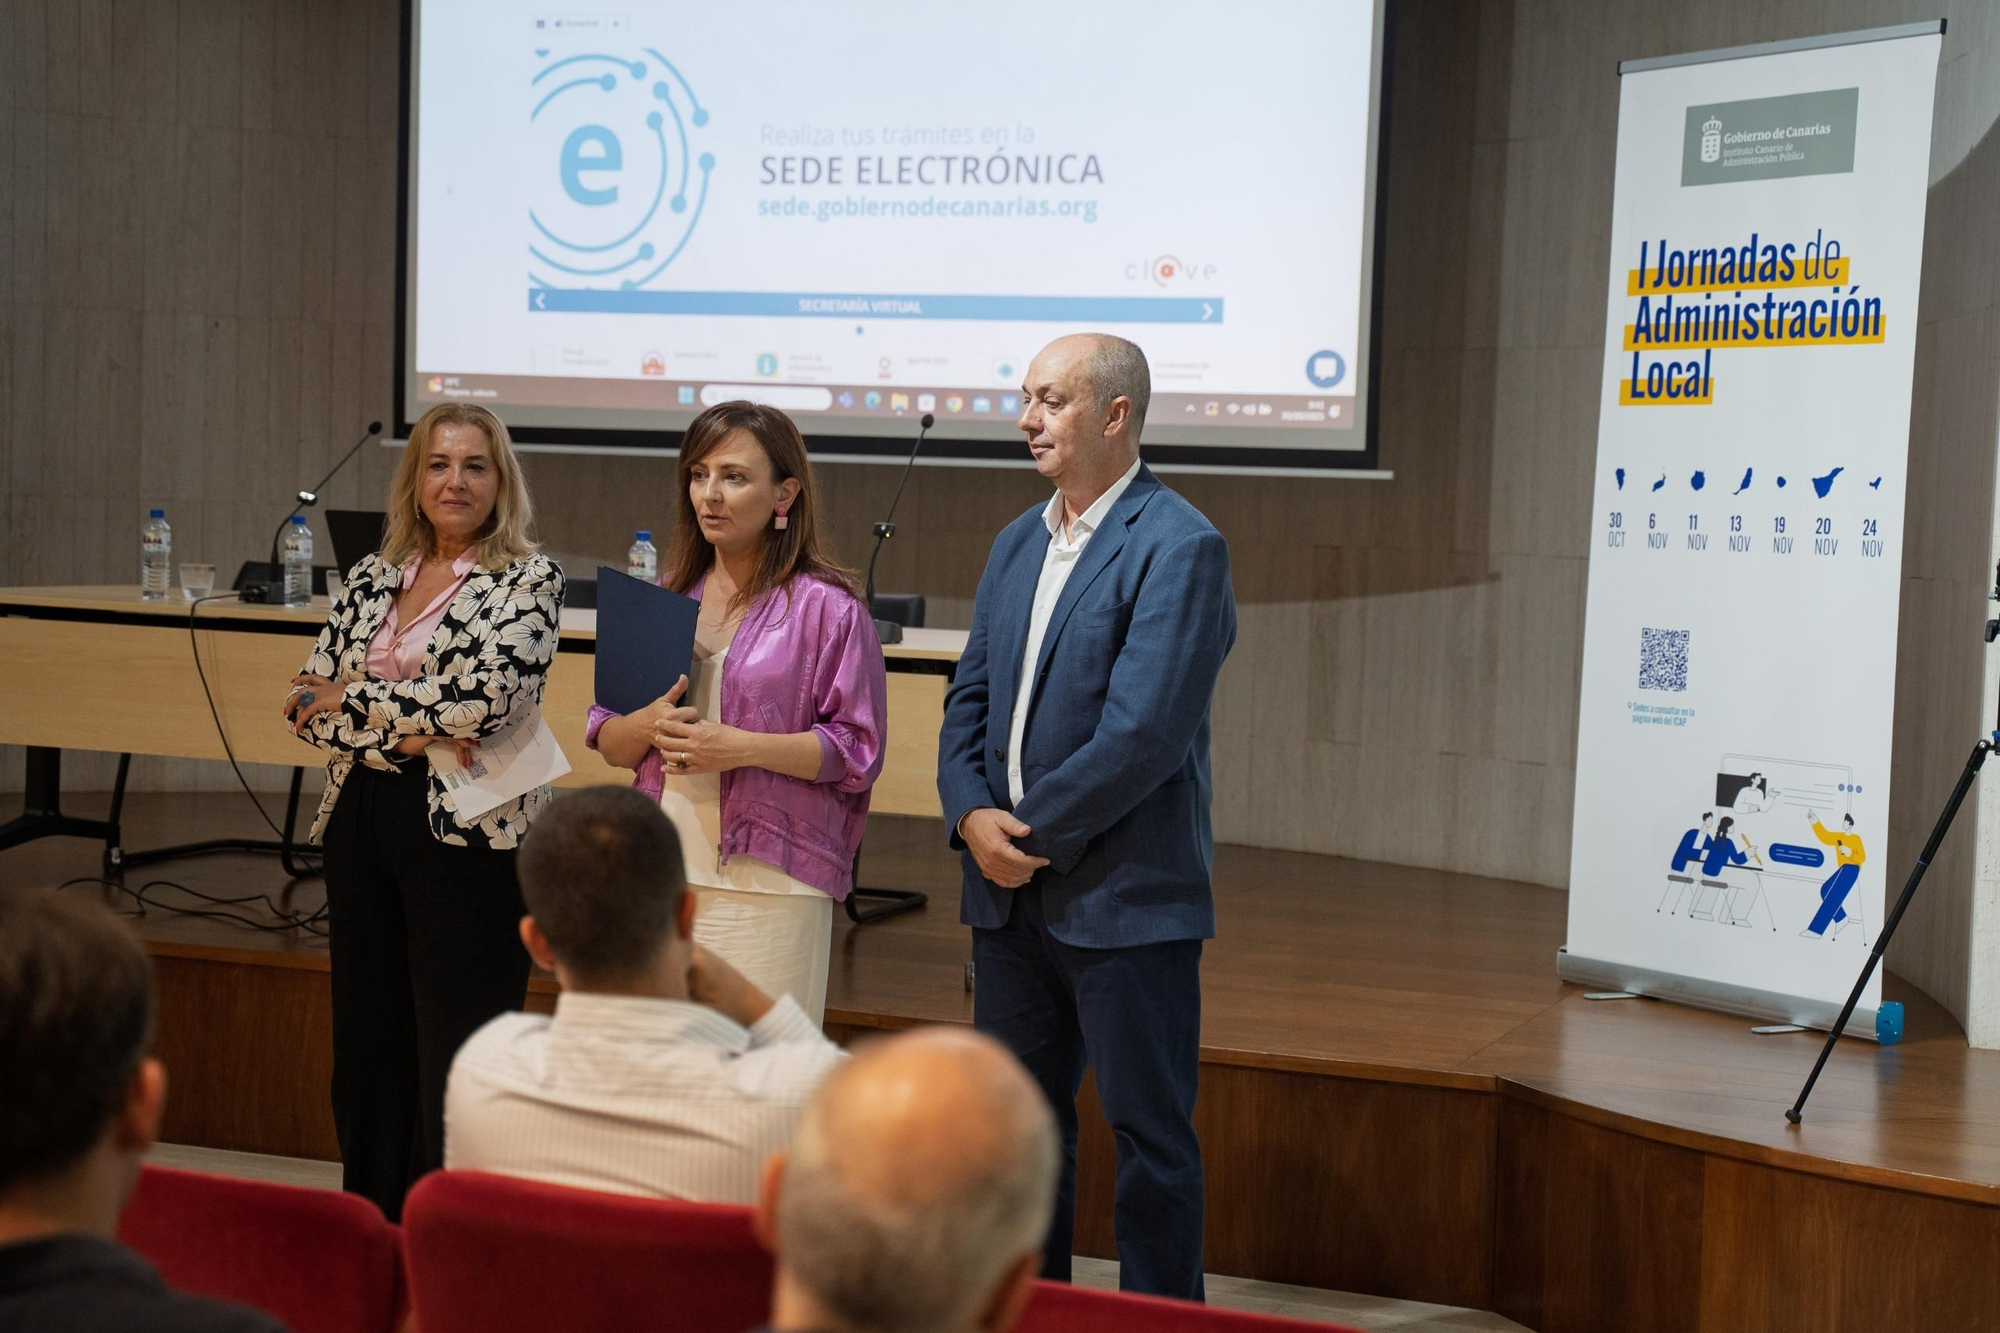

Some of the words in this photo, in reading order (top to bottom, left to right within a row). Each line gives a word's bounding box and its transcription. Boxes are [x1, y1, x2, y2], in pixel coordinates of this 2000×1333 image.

[761, 123, 835, 146] Realiza
[842, 126, 876, 146] tus
[882, 122, 974, 146] trámites
[981, 127, 1009, 146] en
[1016, 122, 1035, 145] la
[1724, 130, 1772, 144] Gobierno
[1773, 128, 1785, 139] de
[1786, 123, 1831, 138] Canarias
[1723, 146, 1754, 157] Instituto
[1755, 143, 1784, 154] Canario
[1785, 142, 1794, 151] de
[1723, 154, 1778, 167] Administración
[1779, 151, 1805, 162] Pública
[760, 155, 843, 184] SEDE
[856, 147, 1104, 184] ELECTRÓNICA
[758, 194, 1099, 222] sede.gobiernodecanarias.org
[1638, 241, 1648, 289] I
[1652, 233, 1796, 288] Jornadas
[1804, 228, 1841, 281] de
[799, 296, 870, 314] SECRETARÍA
[871, 299, 922, 315] VIRTUAL
[1632, 285, 1882, 344] Administración
[1630, 348, 1712, 399] Local
[1609, 512, 1622, 529] 30
[1649, 513, 1656, 530] 6
[1689, 514, 1698, 531] 11
[1730, 515, 1742, 532] 13
[1774, 517, 1786, 533] 19
[1815, 518, 1831, 535] 20
[1862, 519, 1877, 536] 24
[1608, 531, 1626, 548] OCT
[1647, 532, 1668, 549] NOV
[1687, 534, 1708, 551] NOV
[1728, 535, 1751, 552] NOV
[1773, 537, 1794, 554] NOV
[1814, 538, 1838, 556] NOV
[1862, 540, 1884, 558] NOV
[1633, 702, 1650, 713] Sedes
[1655, 705, 1681, 715] consultar
[1689, 708, 1695, 717] la
